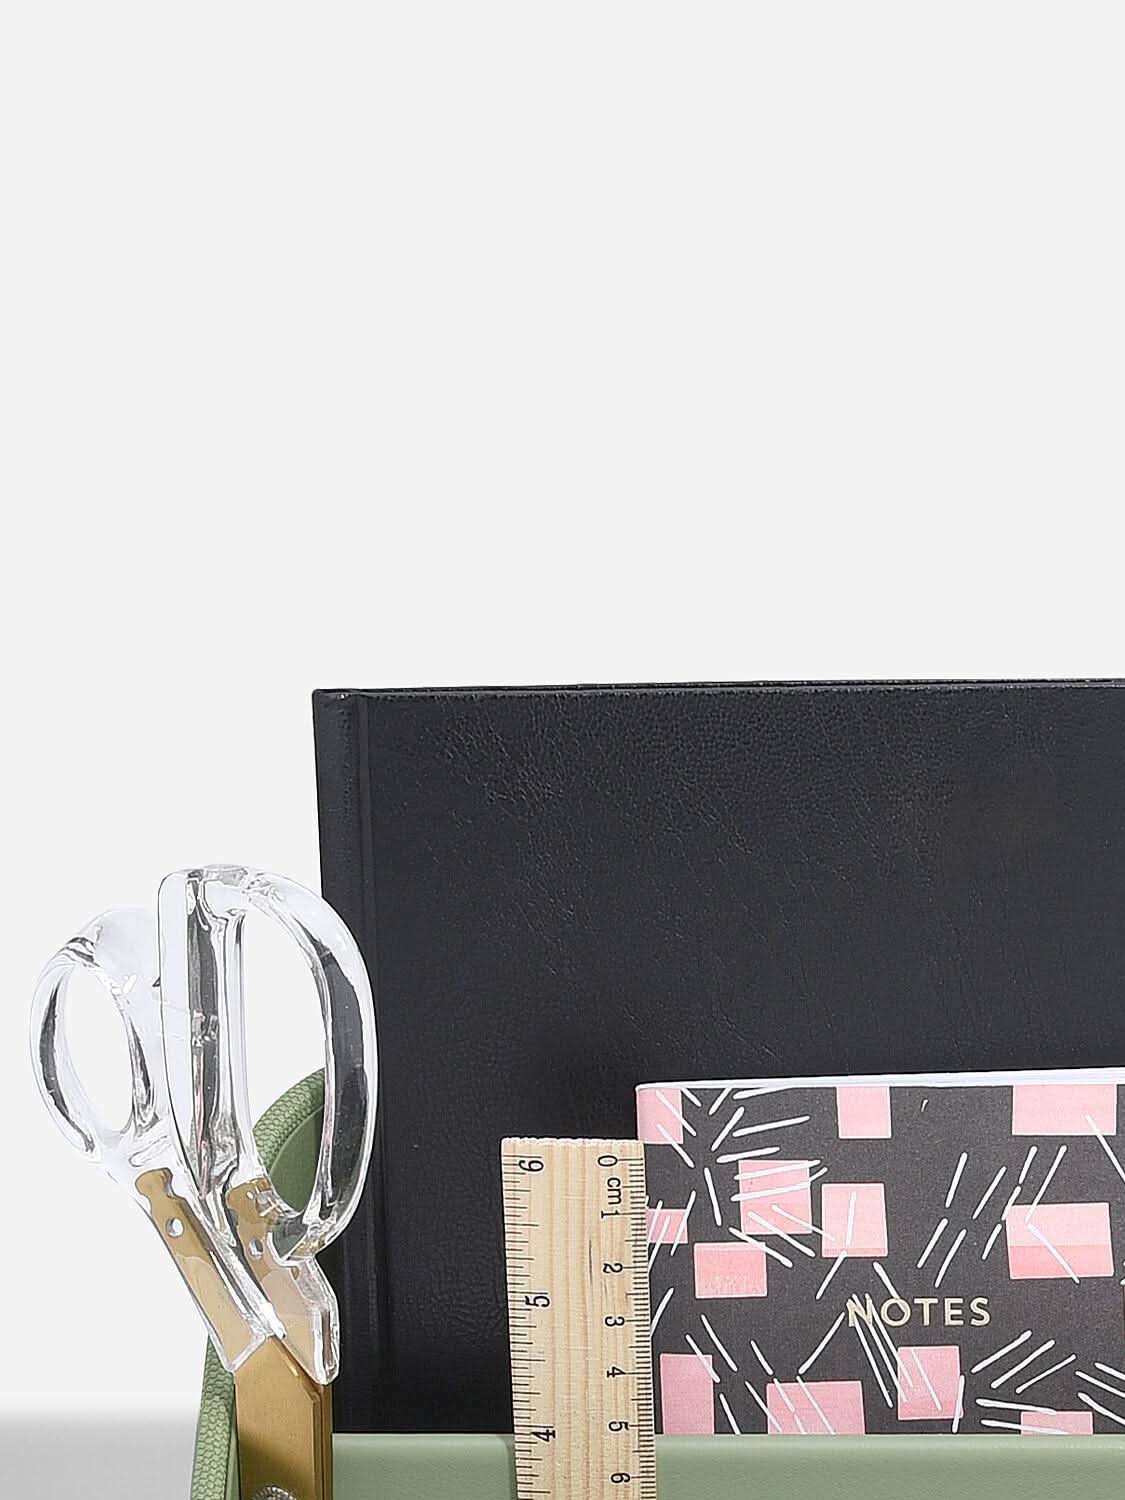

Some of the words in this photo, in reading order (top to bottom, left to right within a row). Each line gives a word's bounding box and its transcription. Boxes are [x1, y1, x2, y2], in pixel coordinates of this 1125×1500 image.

[518, 1159, 544, 1173] 6
[597, 1154, 618, 1168] 0
[606, 1176, 622, 1206] cm
[600, 1209, 619, 1219] 1
[602, 1262, 623, 1274] 2
[525, 1295, 550, 1308] 5
[846, 1297, 992, 1327] NOTES
[604, 1315, 625, 1328] 3
[606, 1366, 626, 1378] 4
[608, 1420, 629, 1432] 5
[531, 1427, 556, 1442] 4
[610, 1472, 631, 1484] 6
